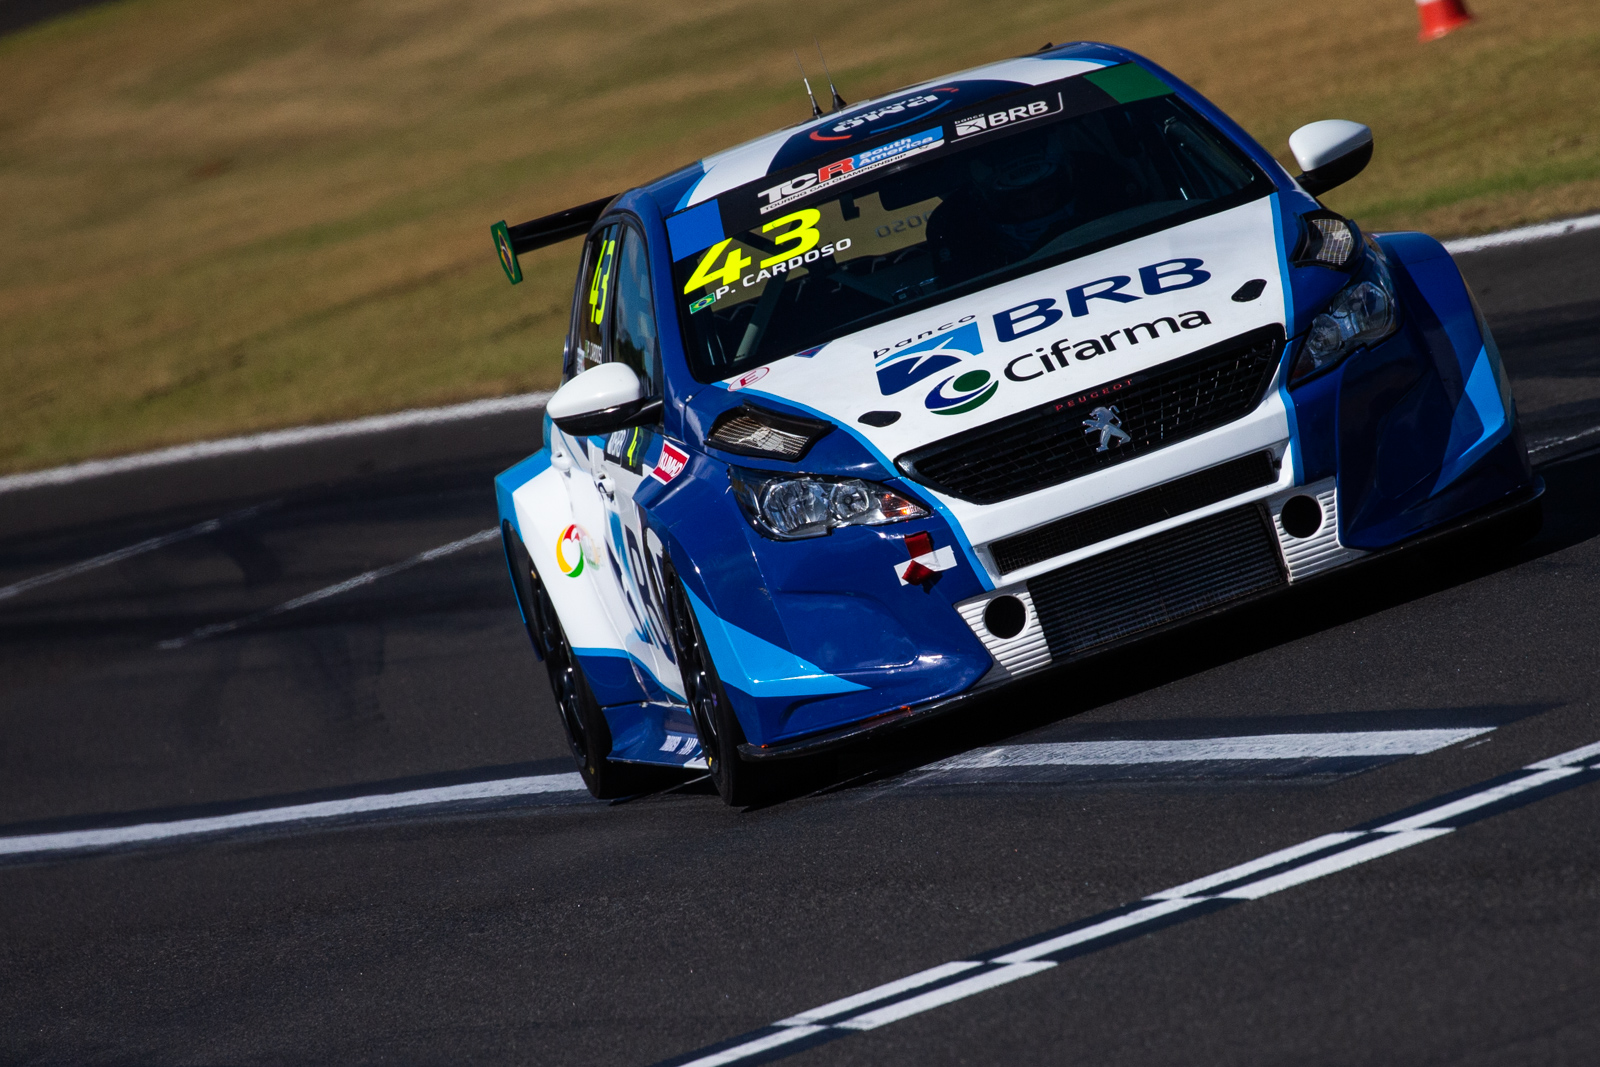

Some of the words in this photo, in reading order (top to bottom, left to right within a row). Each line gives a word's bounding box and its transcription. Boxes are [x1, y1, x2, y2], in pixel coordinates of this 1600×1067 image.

[954, 113, 985, 125] banco
[988, 101, 1049, 127] BRB
[858, 135, 933, 166] America
[859, 137, 912, 158] South
[757, 157, 856, 203] TCR
[765, 190, 809, 211] TOURING
[809, 181, 831, 195] CAR
[831, 153, 907, 186] CHAMPIONSHIP
[684, 208, 821, 295] 43
[715, 284, 736, 301] P.
[742, 238, 852, 287] CARDOSO
[589, 240, 615, 325] 43
[992, 257, 1212, 344] BRB
[873, 314, 976, 360] banco
[1003, 309, 1212, 383] Cifarma
[1055, 378, 1132, 412] PEUGEOT
[658, 450, 684, 478] KUMHO
